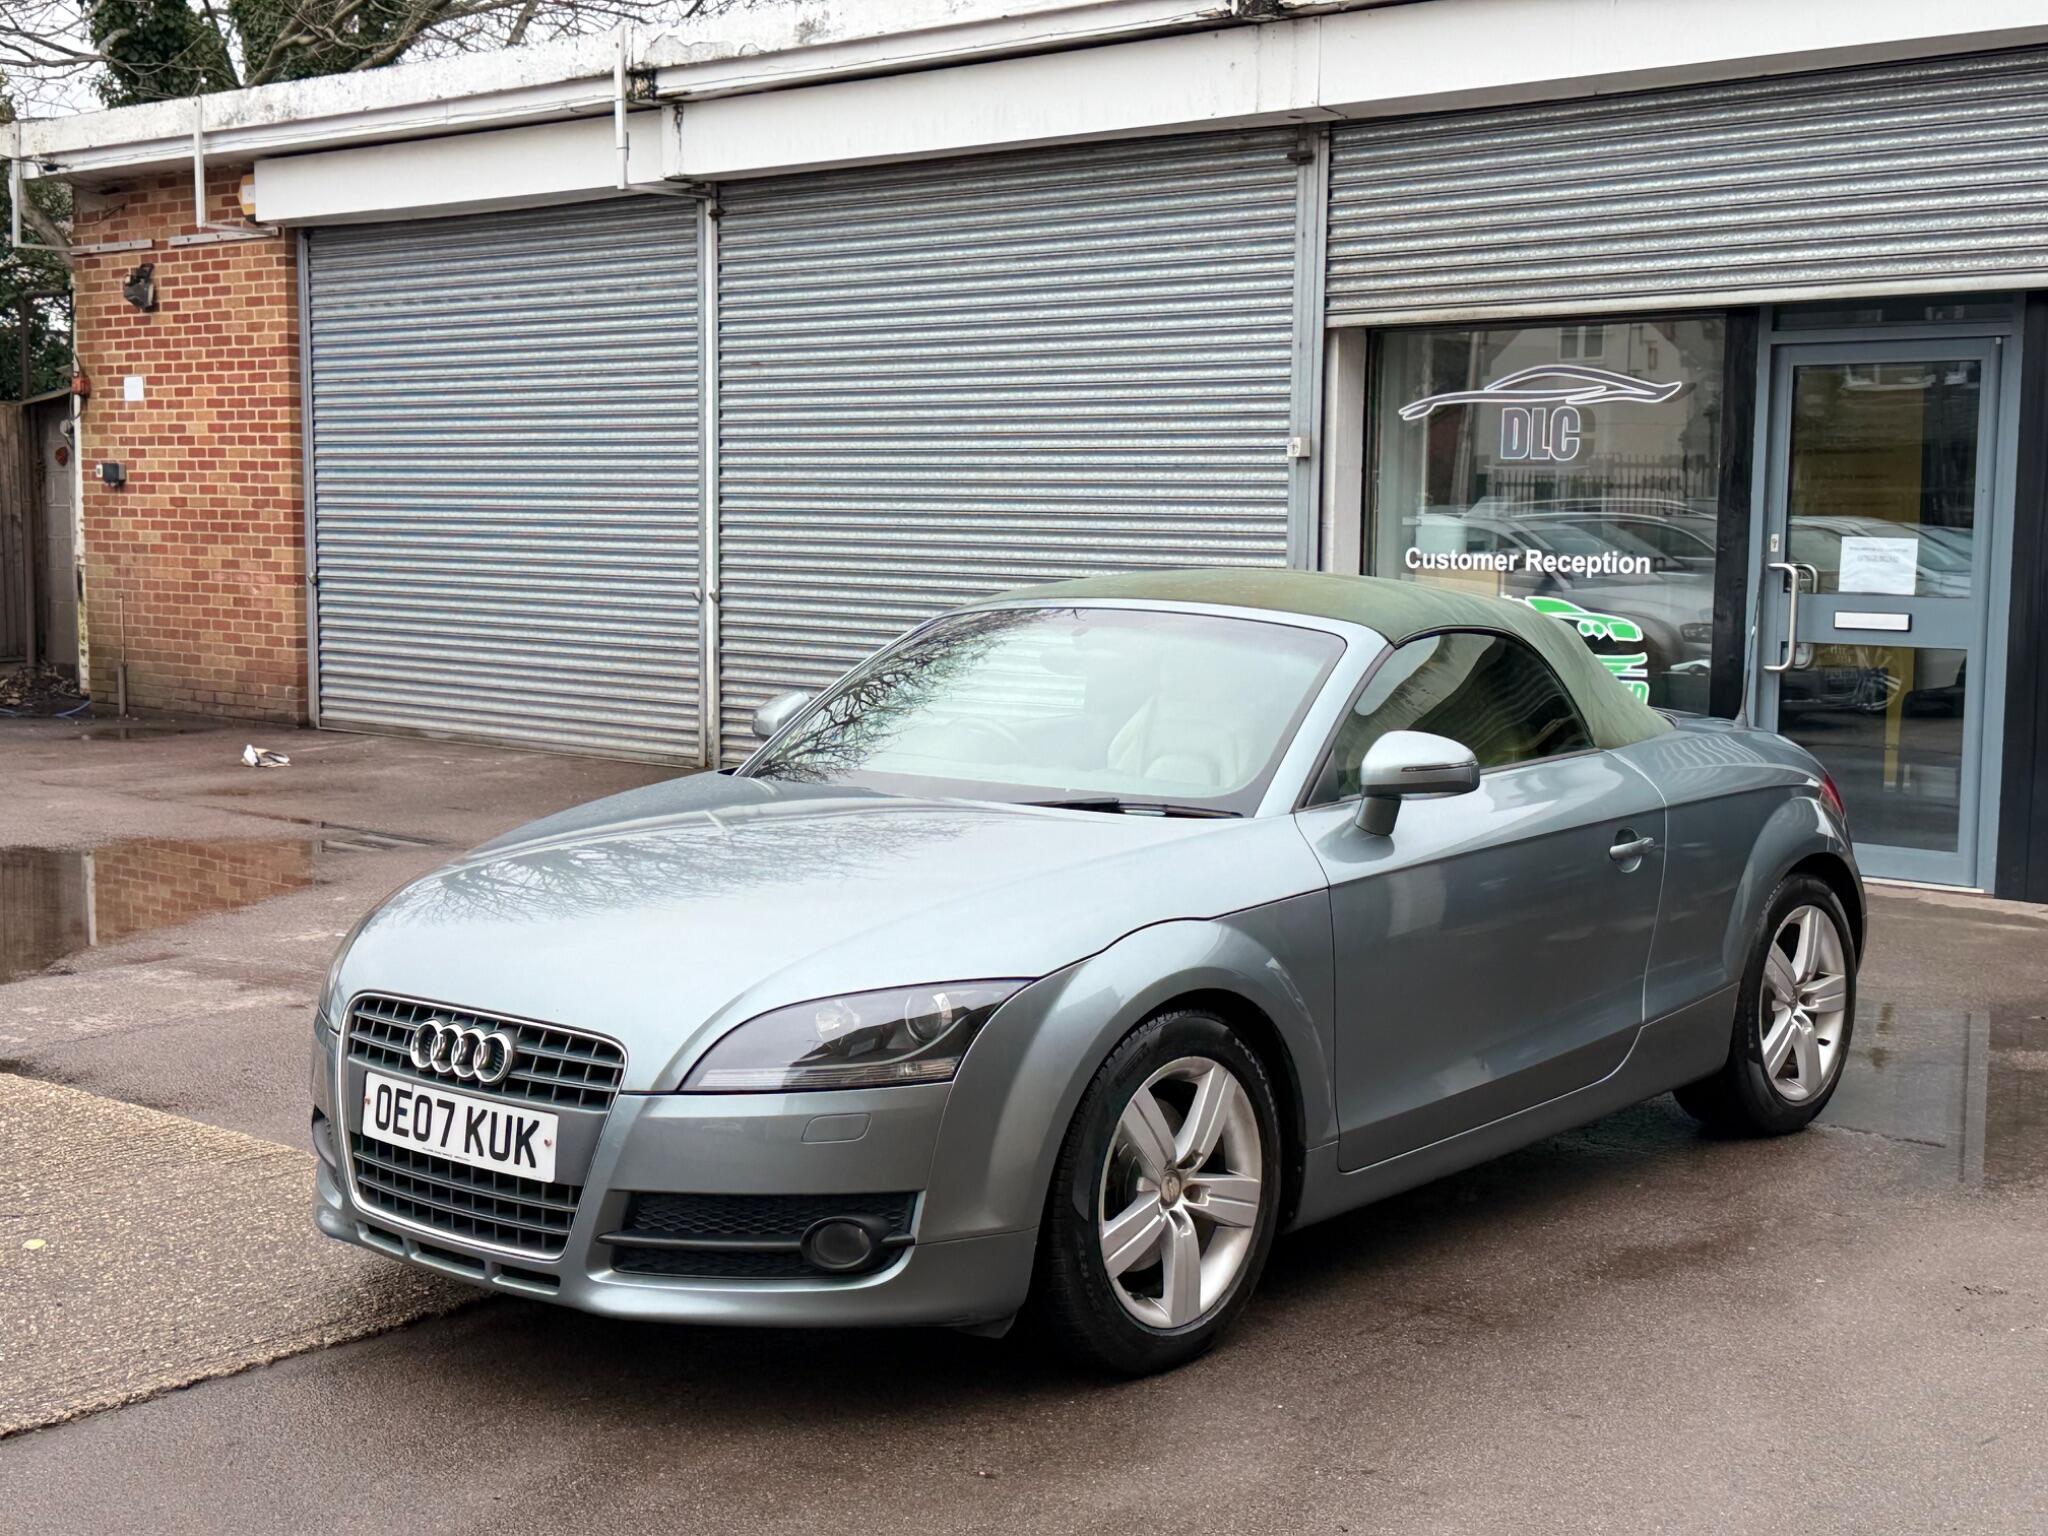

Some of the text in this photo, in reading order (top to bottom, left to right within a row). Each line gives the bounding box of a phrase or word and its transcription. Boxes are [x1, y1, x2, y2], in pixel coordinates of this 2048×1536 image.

[1500, 405, 1581, 462] DLC
[1404, 547, 1650, 578] Customer Reception
[375, 1083, 541, 1169] OE07 KUK
